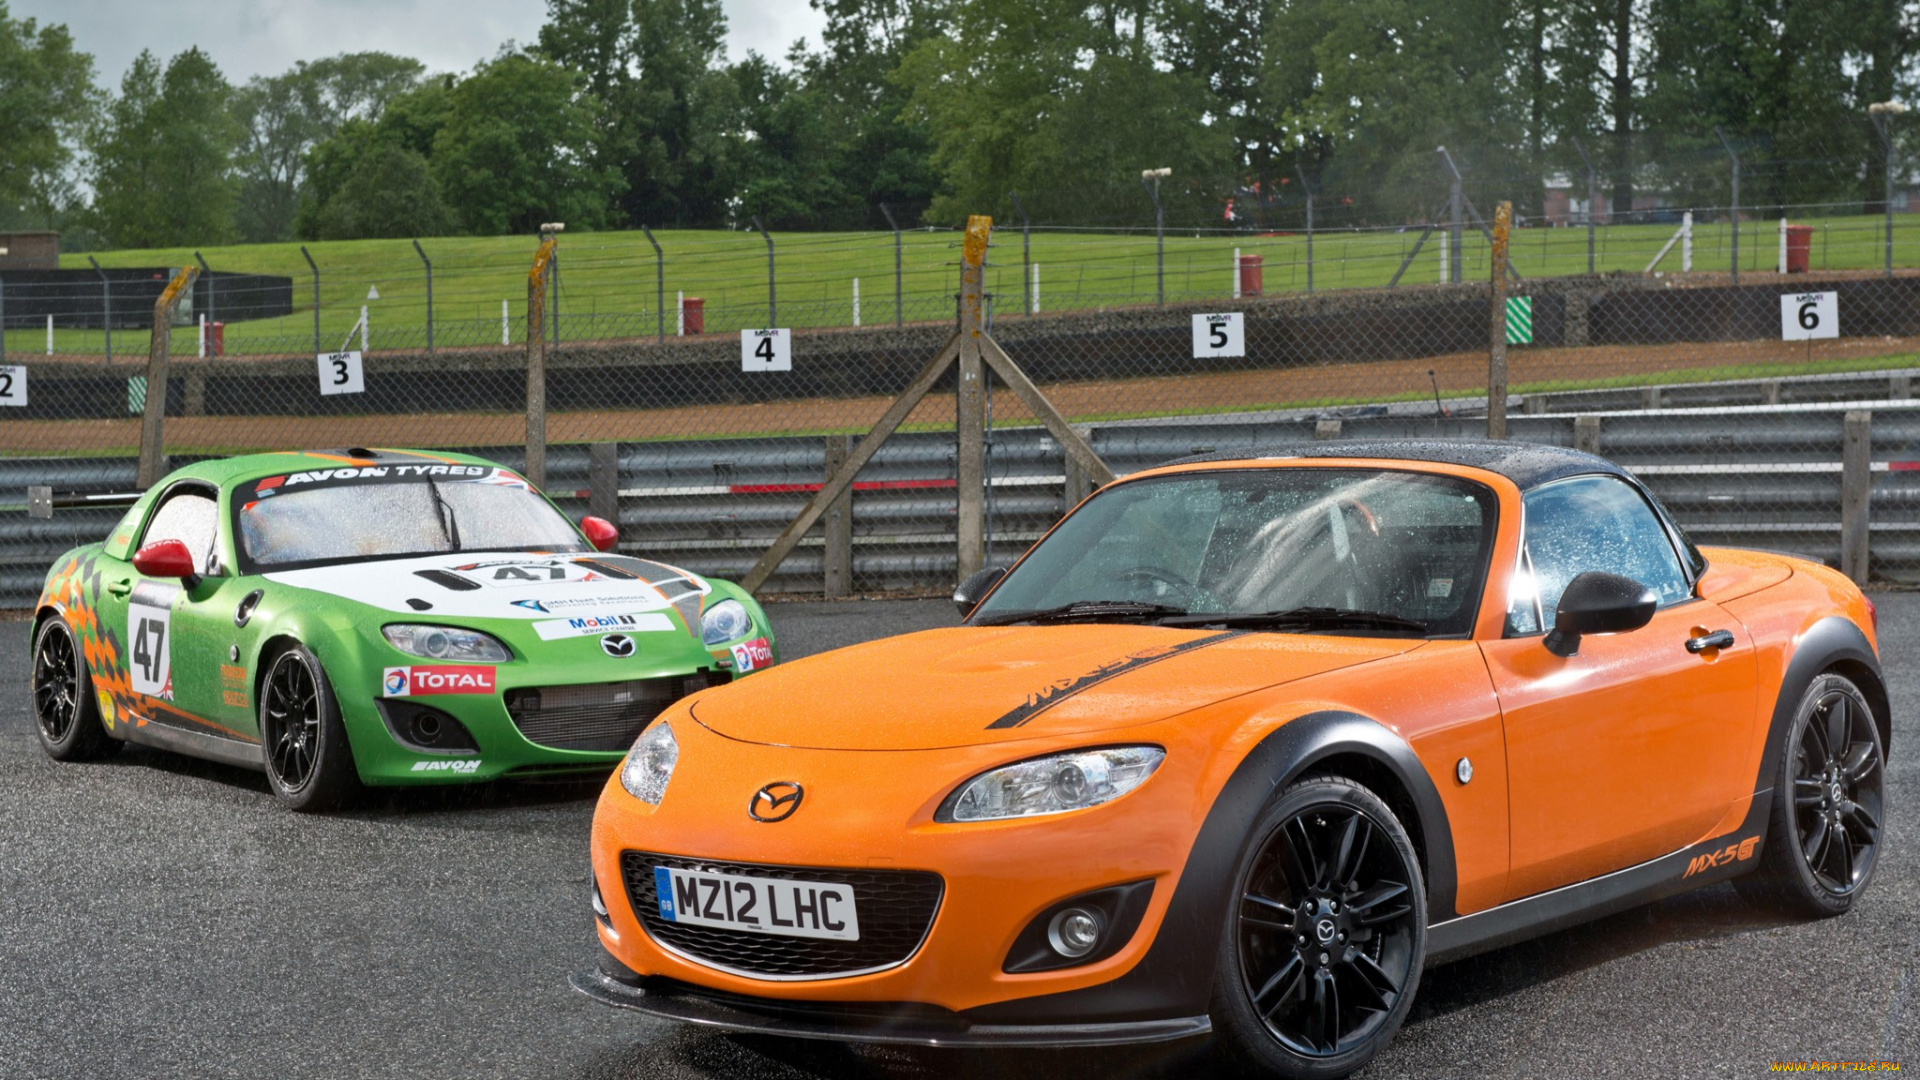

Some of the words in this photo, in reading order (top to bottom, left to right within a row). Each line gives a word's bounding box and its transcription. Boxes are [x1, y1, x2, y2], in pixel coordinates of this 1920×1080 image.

[1798, 302, 1820, 330] 6
[1210, 322, 1228, 348] 5
[755, 337, 775, 362] 4
[333, 360, 349, 385] 3
[0, 374, 13, 397] 2
[285, 466, 389, 486] AVON
[396, 465, 484, 476] TYRES
[492, 566, 566, 581] 47
[568, 615, 619, 629] Mobil
[619, 615, 637, 624] 1
[582, 627, 609, 635] SERVICE
[133, 617, 165, 683] 47
[413, 671, 492, 688] TOTAL
[426, 760, 482, 771] AVON
[661, 899, 673, 911] GB
[675, 875, 760, 925] MZ12
[767, 884, 846, 932] LHC
